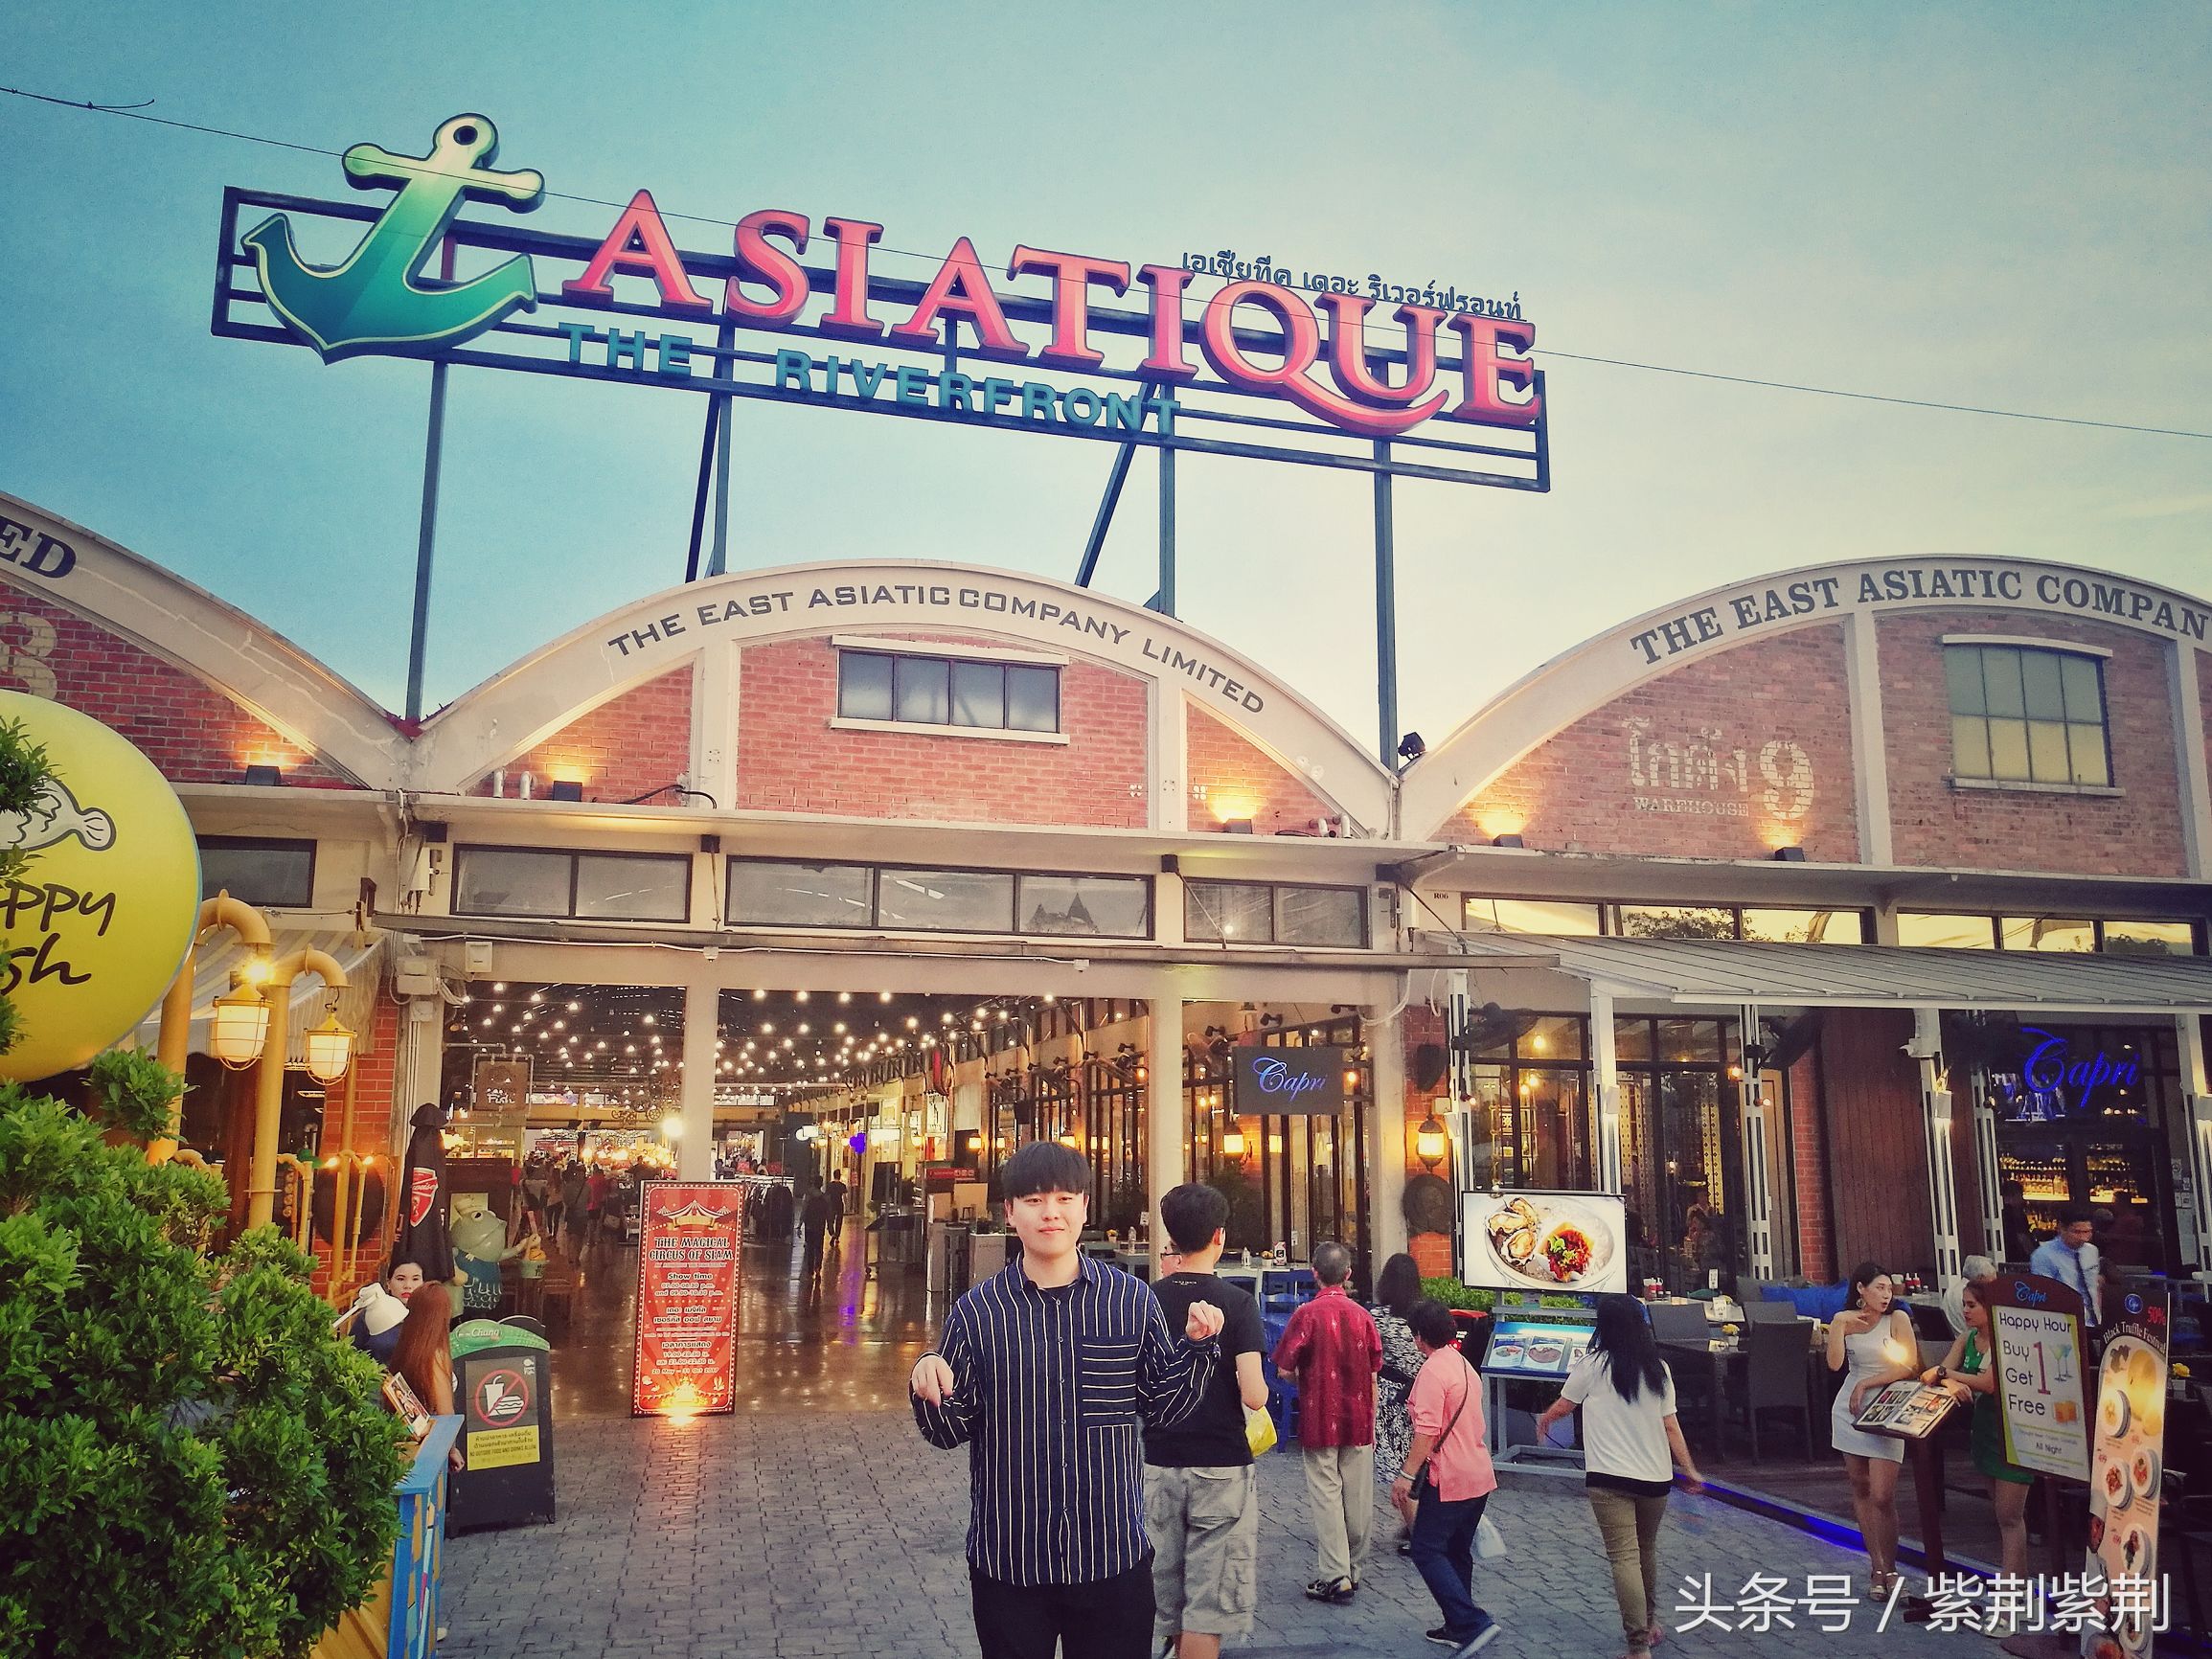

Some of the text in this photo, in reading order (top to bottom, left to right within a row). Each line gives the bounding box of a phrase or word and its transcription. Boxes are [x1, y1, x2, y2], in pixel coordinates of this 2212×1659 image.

[1181, 248, 1521, 321] เอเชียทีค เดอะ ริเวอร์ฟรอนท์
[562, 189, 1541, 435] ASIATIQUE
[559, 321, 1181, 438] THE RIVERFRONT
[1630, 569, 2212, 666] THE EAST ASIATIC COMPAN
[608, 584, 1265, 714] THE EAST ASIATIC COMPANY LIMITED
[1759, 739, 1815, 820] 9
[1632, 796, 1749, 817] WAREHOUSE
[0, 878, 116, 936] ppy
[1252, 1057, 1329, 1102] Capri
[2019, 1026, 2141, 1109] Capri
[650, 1249, 734, 1261] CIRCUS OF SIAM
[654, 1236, 730, 1248] THE MAGICAL
[668, 1272, 713, 1281] Show time
[2014, 1281, 2048, 1307] Capri
[1998, 1311, 2072, 1333] Happy Hour
[2102, 1321, 2167, 1354] Black Truffle Festival
[2002, 1340, 2030, 1362] Buy
[2033, 1341, 2052, 1395] 1
[2005, 1367, 2033, 1386] Get
[2008, 1394, 2046, 1416] Free
